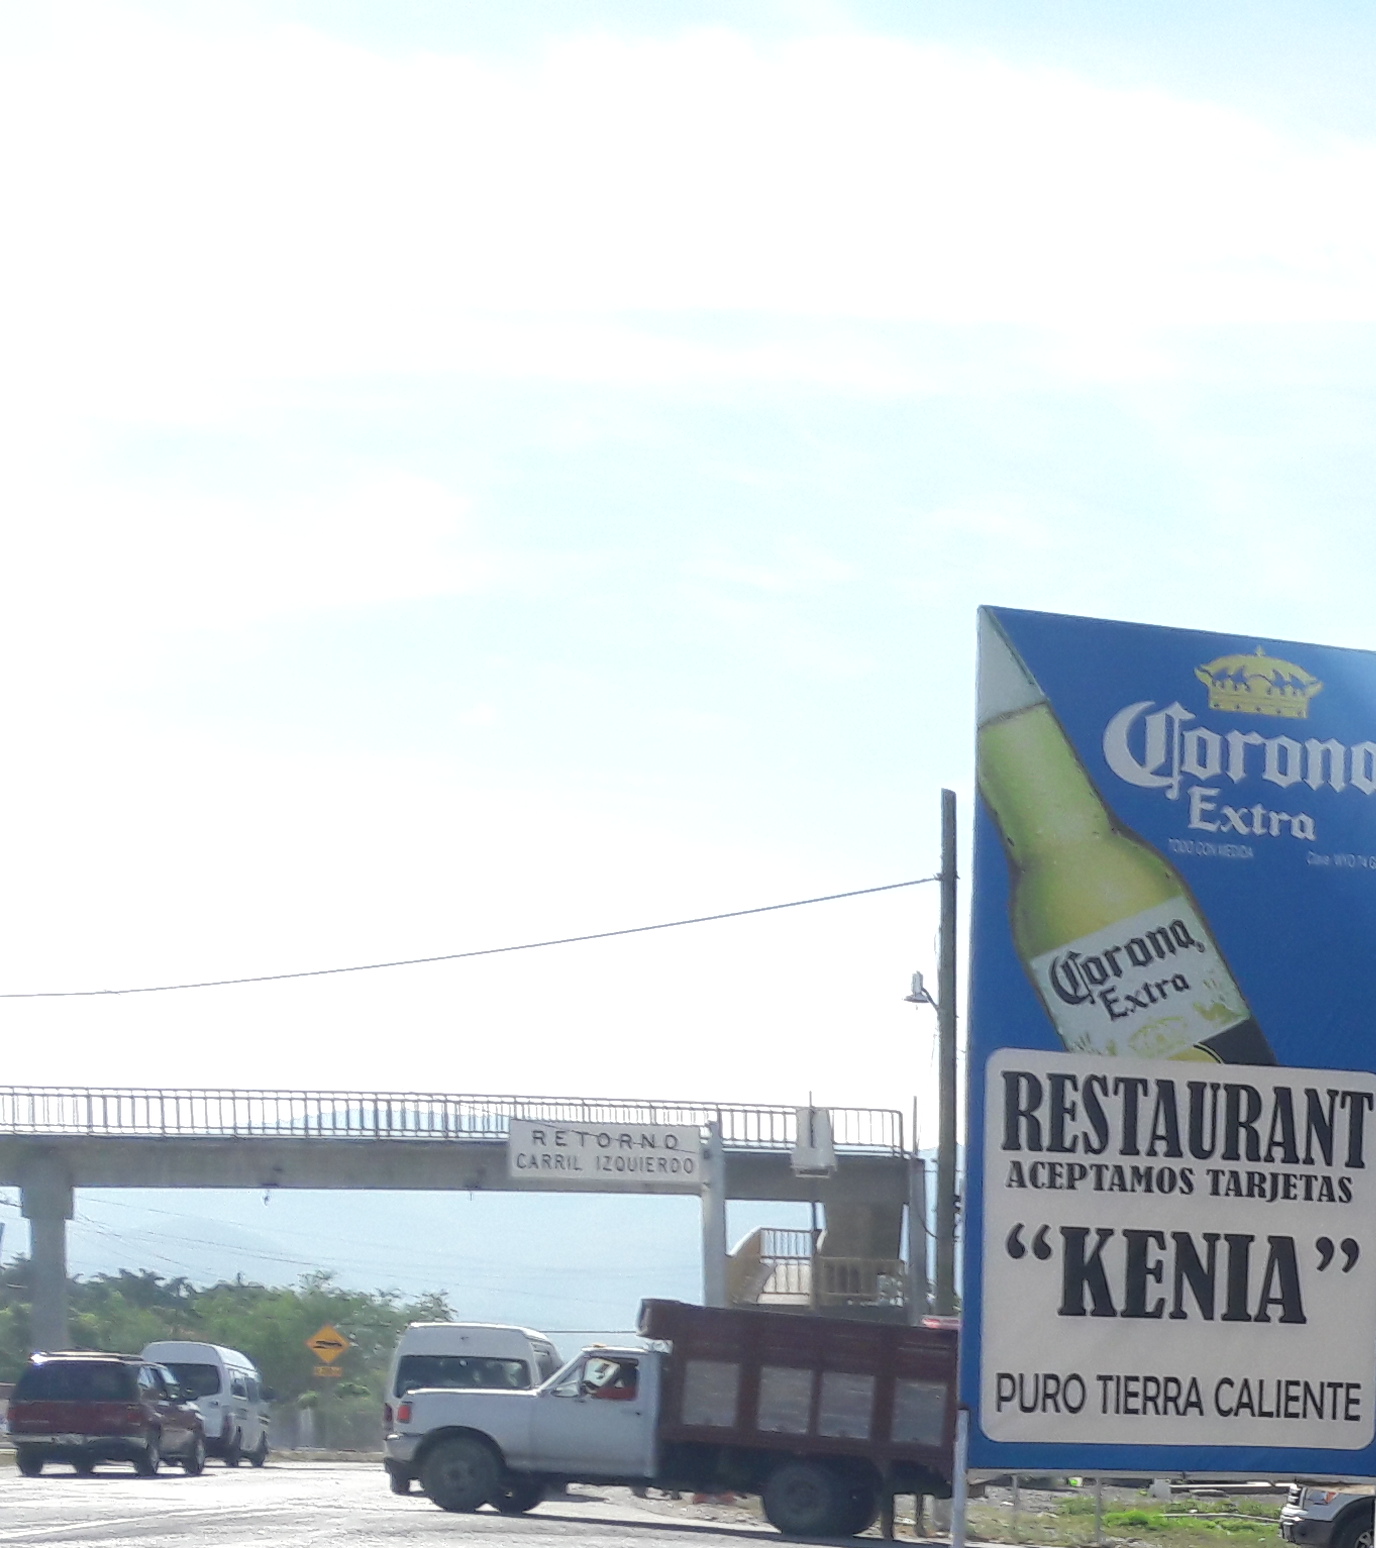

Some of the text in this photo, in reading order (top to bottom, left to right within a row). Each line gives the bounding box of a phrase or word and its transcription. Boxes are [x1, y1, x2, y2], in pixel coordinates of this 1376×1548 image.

[1187, 786, 1317, 842] Extra
[1048, 918, 1202, 1006] Corona
[1097, 972, 1190, 1021] Extra
[531, 1129, 679, 1150] RETORNO
[1000, 1070, 1375, 1169] RESTAURANT
[516, 1153, 694, 1174] CARRIL IZQUIERDO
[1005, 1160, 1353, 1204] ACEPTAMOS TARJETAS
[995, 1372, 1362, 1422] PURO TIERRA CALIENTE
